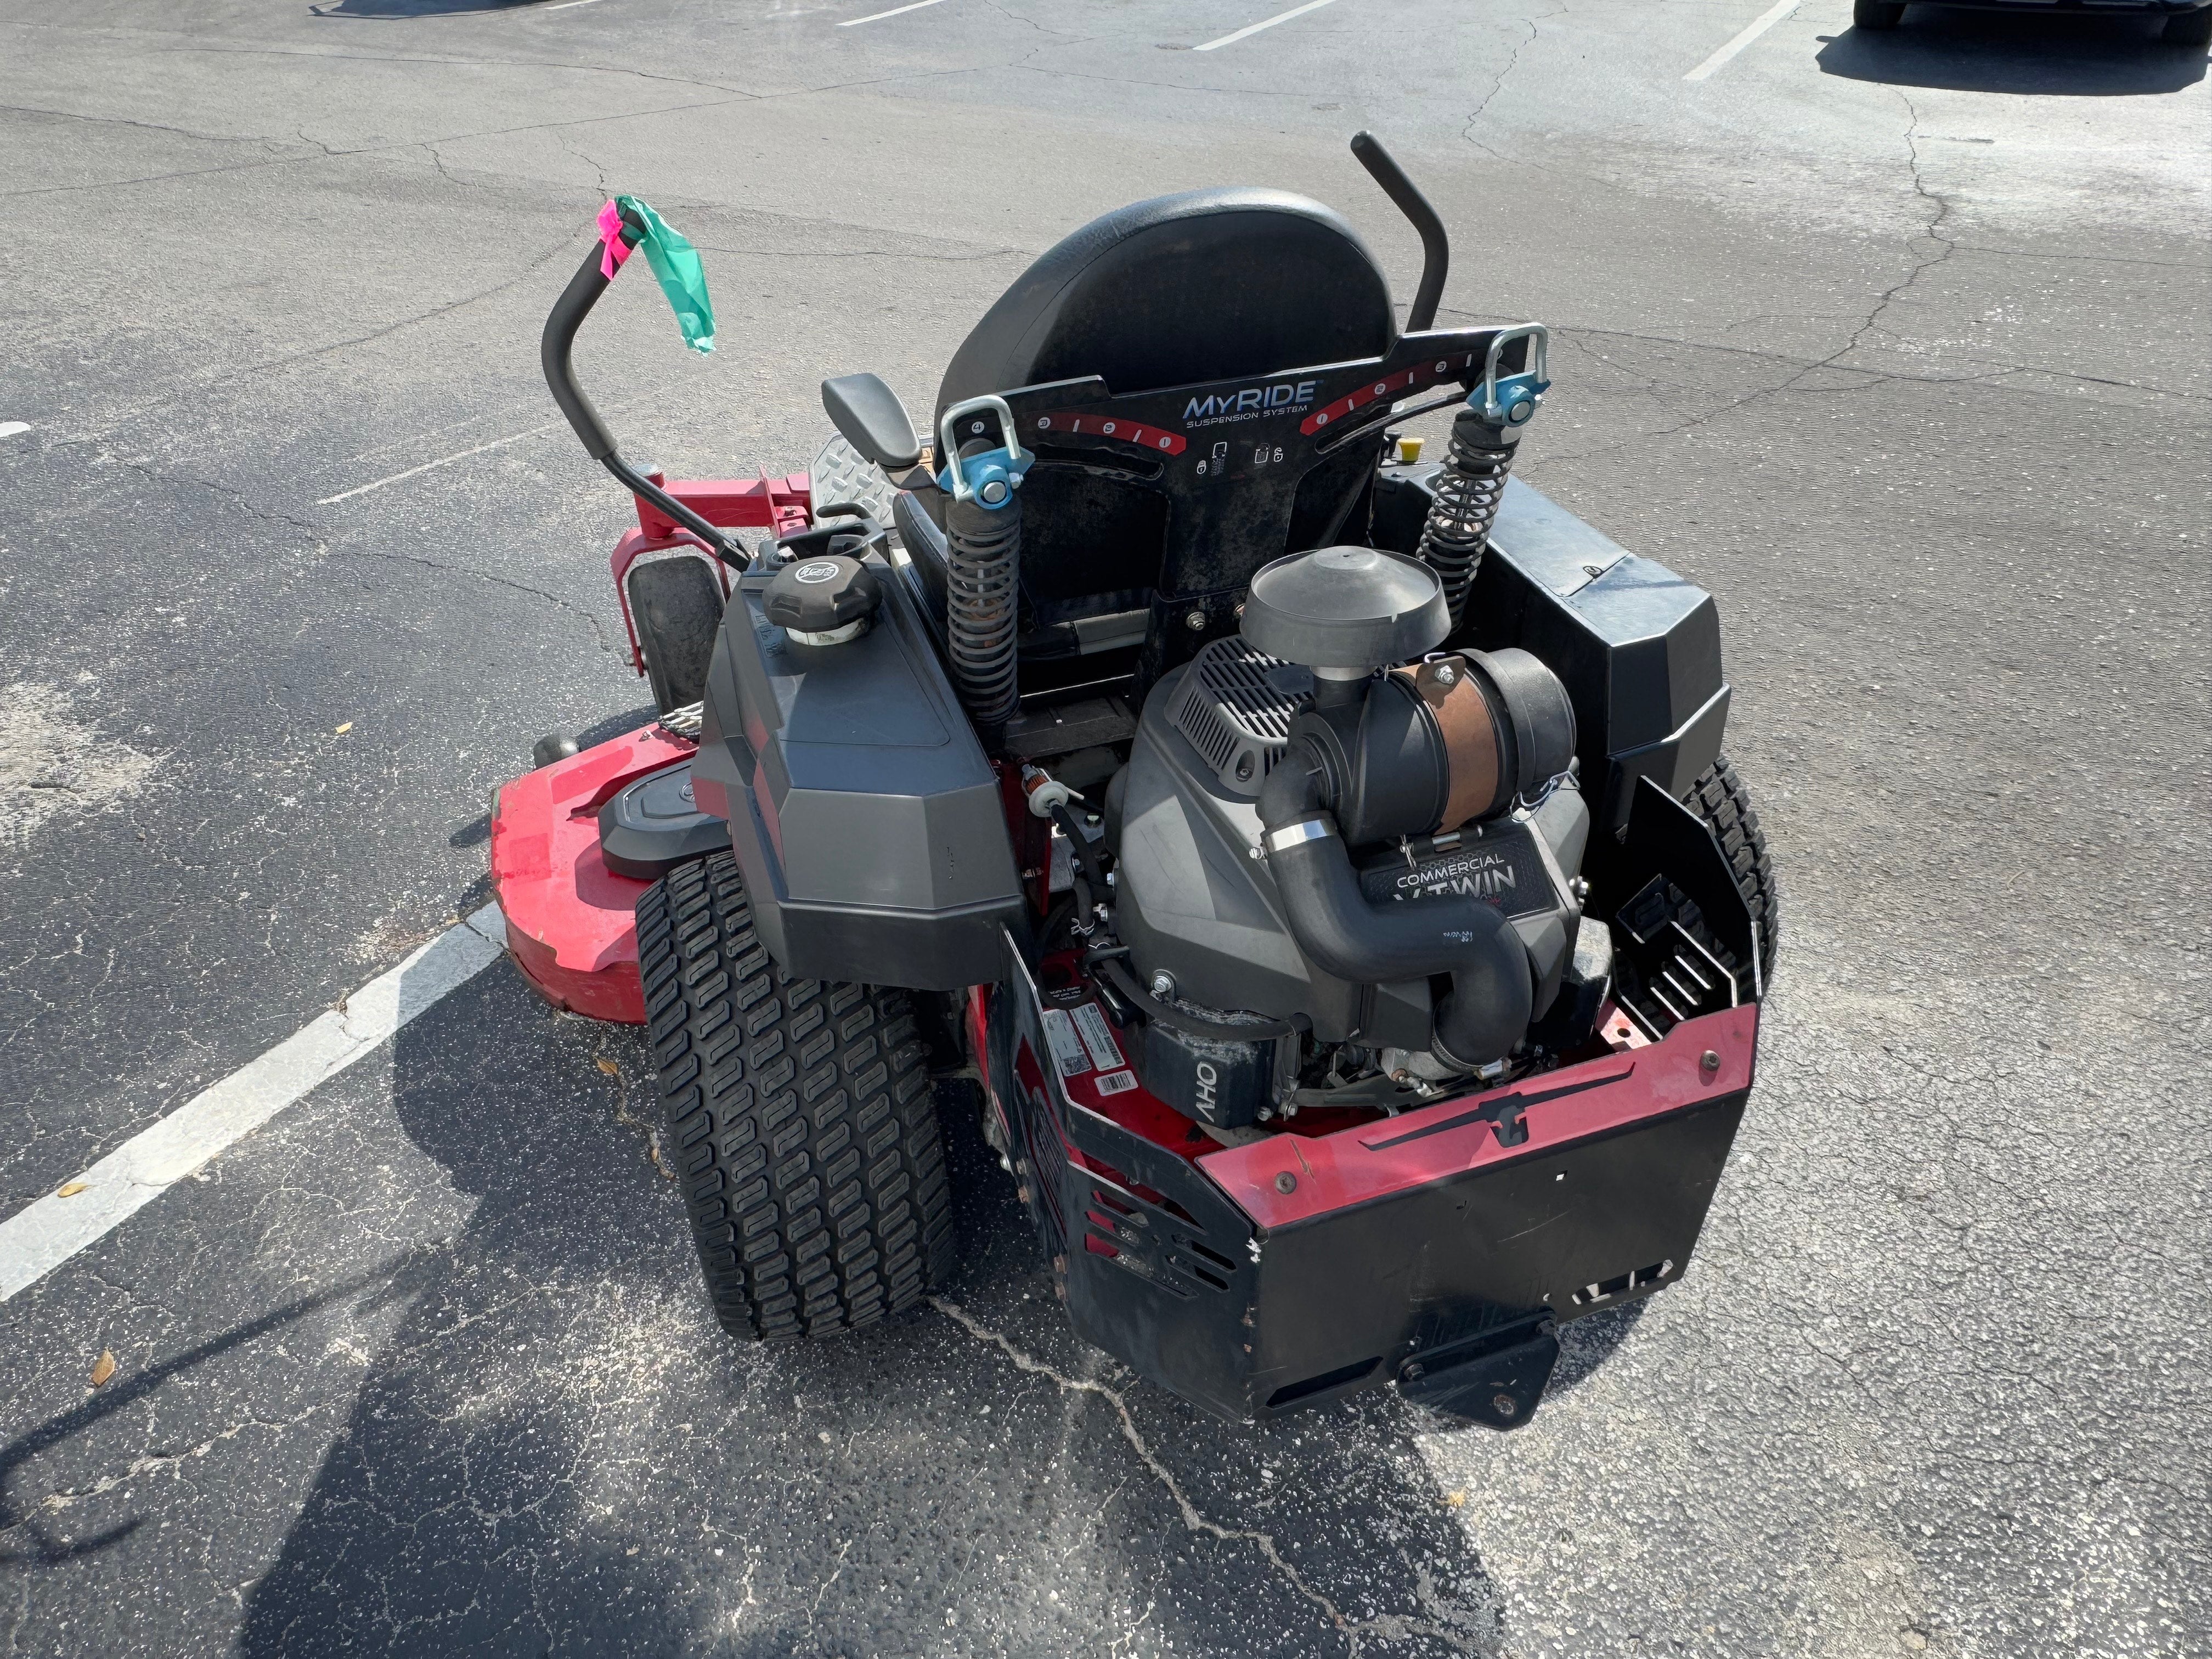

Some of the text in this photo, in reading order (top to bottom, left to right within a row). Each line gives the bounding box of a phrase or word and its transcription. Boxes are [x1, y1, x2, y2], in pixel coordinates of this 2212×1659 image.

[1186, 404, 1308, 428] SUSPENSION SYSTEM
[1397, 853, 1505, 889] COMMERCIAL
[1195, 1061, 1217, 1123] OHV
